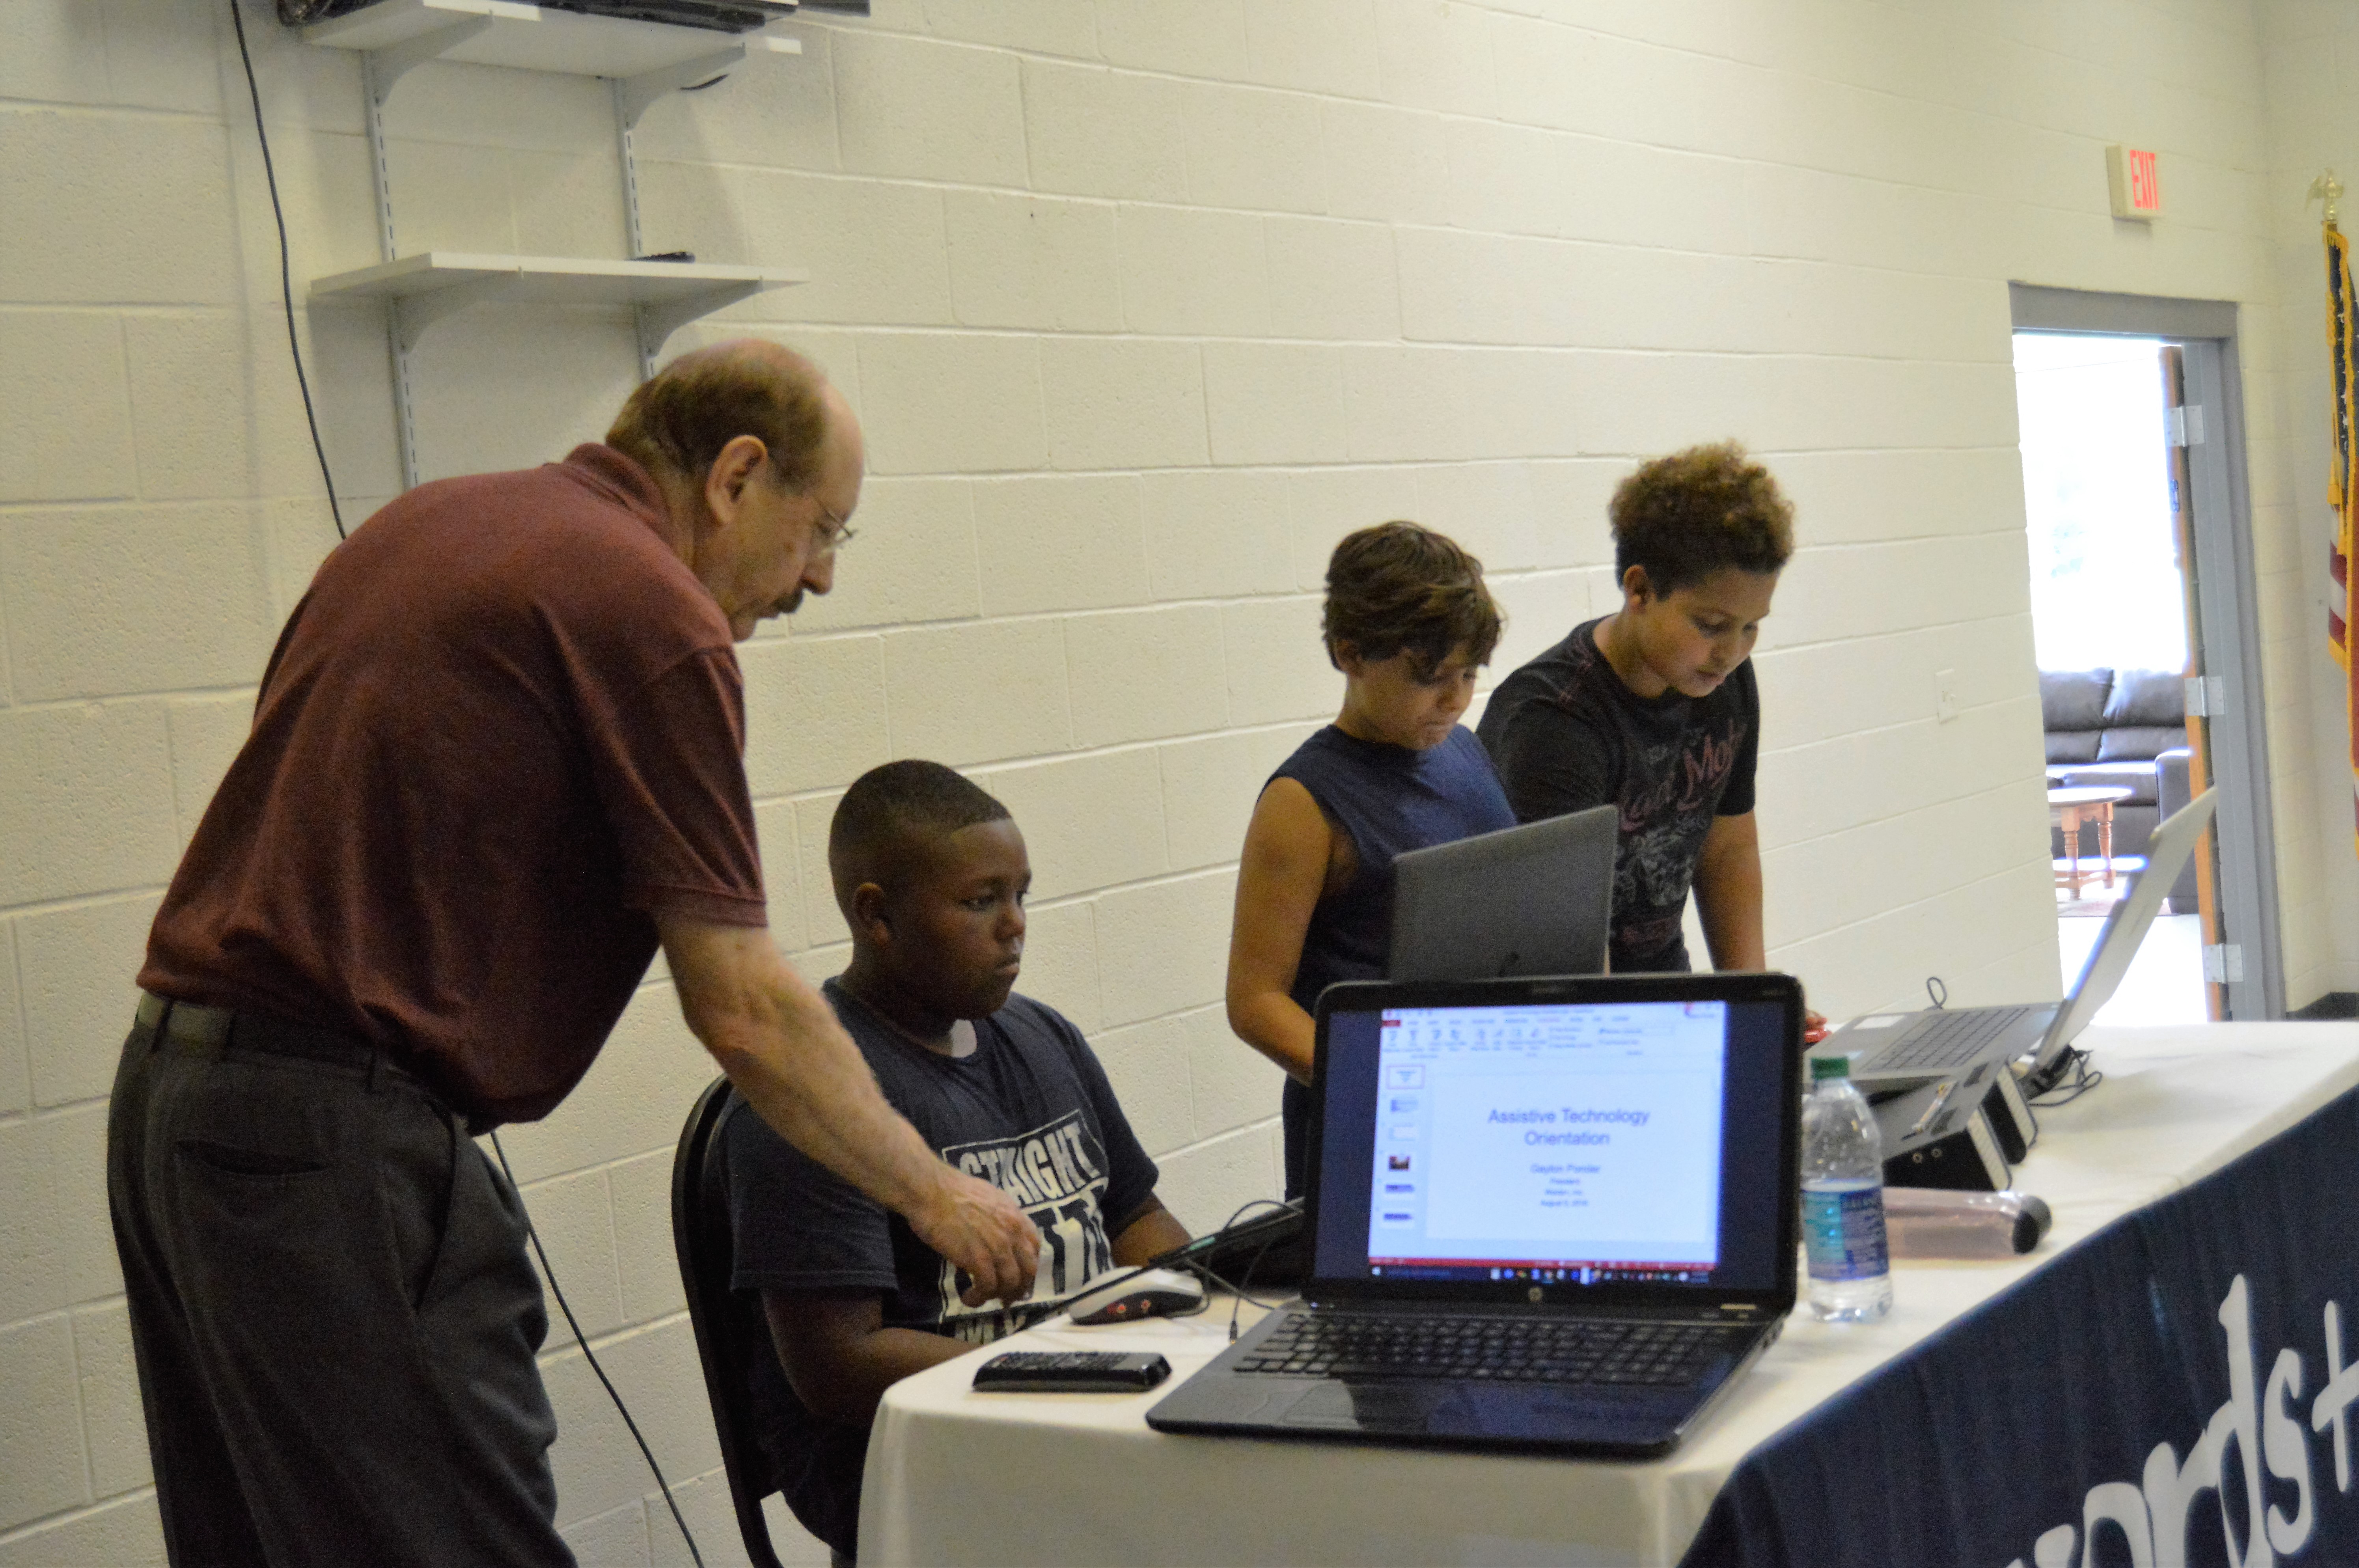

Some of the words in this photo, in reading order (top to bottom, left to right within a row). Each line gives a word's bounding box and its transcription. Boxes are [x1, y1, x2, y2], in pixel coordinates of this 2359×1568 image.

[2130, 149, 2159, 210] EXIT
[1488, 1109, 1556, 1123] Assistive
[1562, 1107, 1650, 1126] Technology
[1524, 1130, 1610, 1145] Orientation
[2006, 1273, 2359, 1568] rds+
